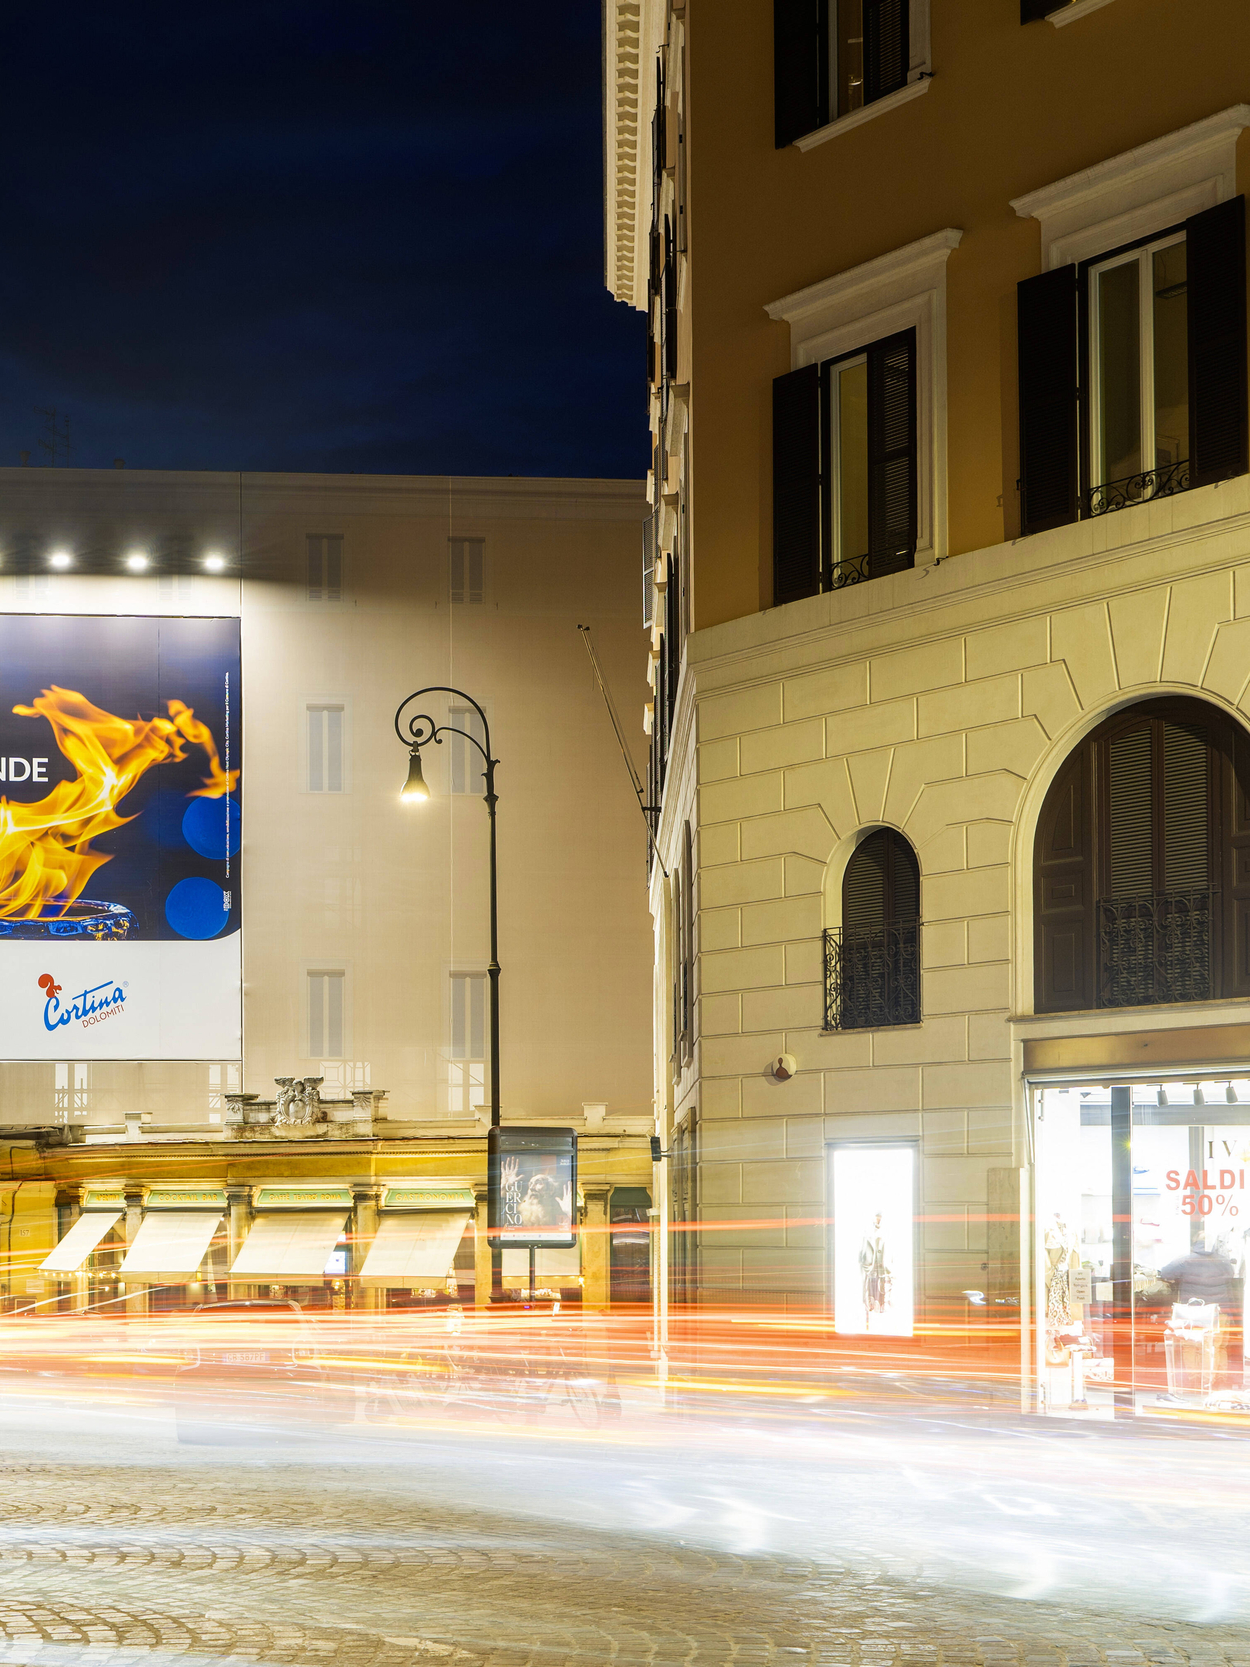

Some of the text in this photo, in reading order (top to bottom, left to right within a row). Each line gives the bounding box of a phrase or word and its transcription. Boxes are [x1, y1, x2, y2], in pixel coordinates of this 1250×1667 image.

[43, 980, 128, 1032] Cortina
[81, 1004, 125, 1029] DOLOMITI
[1165, 1169, 1245, 1191] SALDI
[505, 1181, 523, 1192] GU
[158, 1193, 218, 1202] COCKTAIL BAR
[293, 1193, 318, 1201] TEATRO
[320, 1193, 342, 1201] ROMA
[395, 1193, 465, 1202] GASTRONOMIA
[505, 1192, 522, 1203] ER
[505, 1203, 517, 1214] CI
[1181, 1194, 1239, 1217] 50%
[505, 1213, 523, 1225] NO
[20, 1229, 30, 1237] 157
